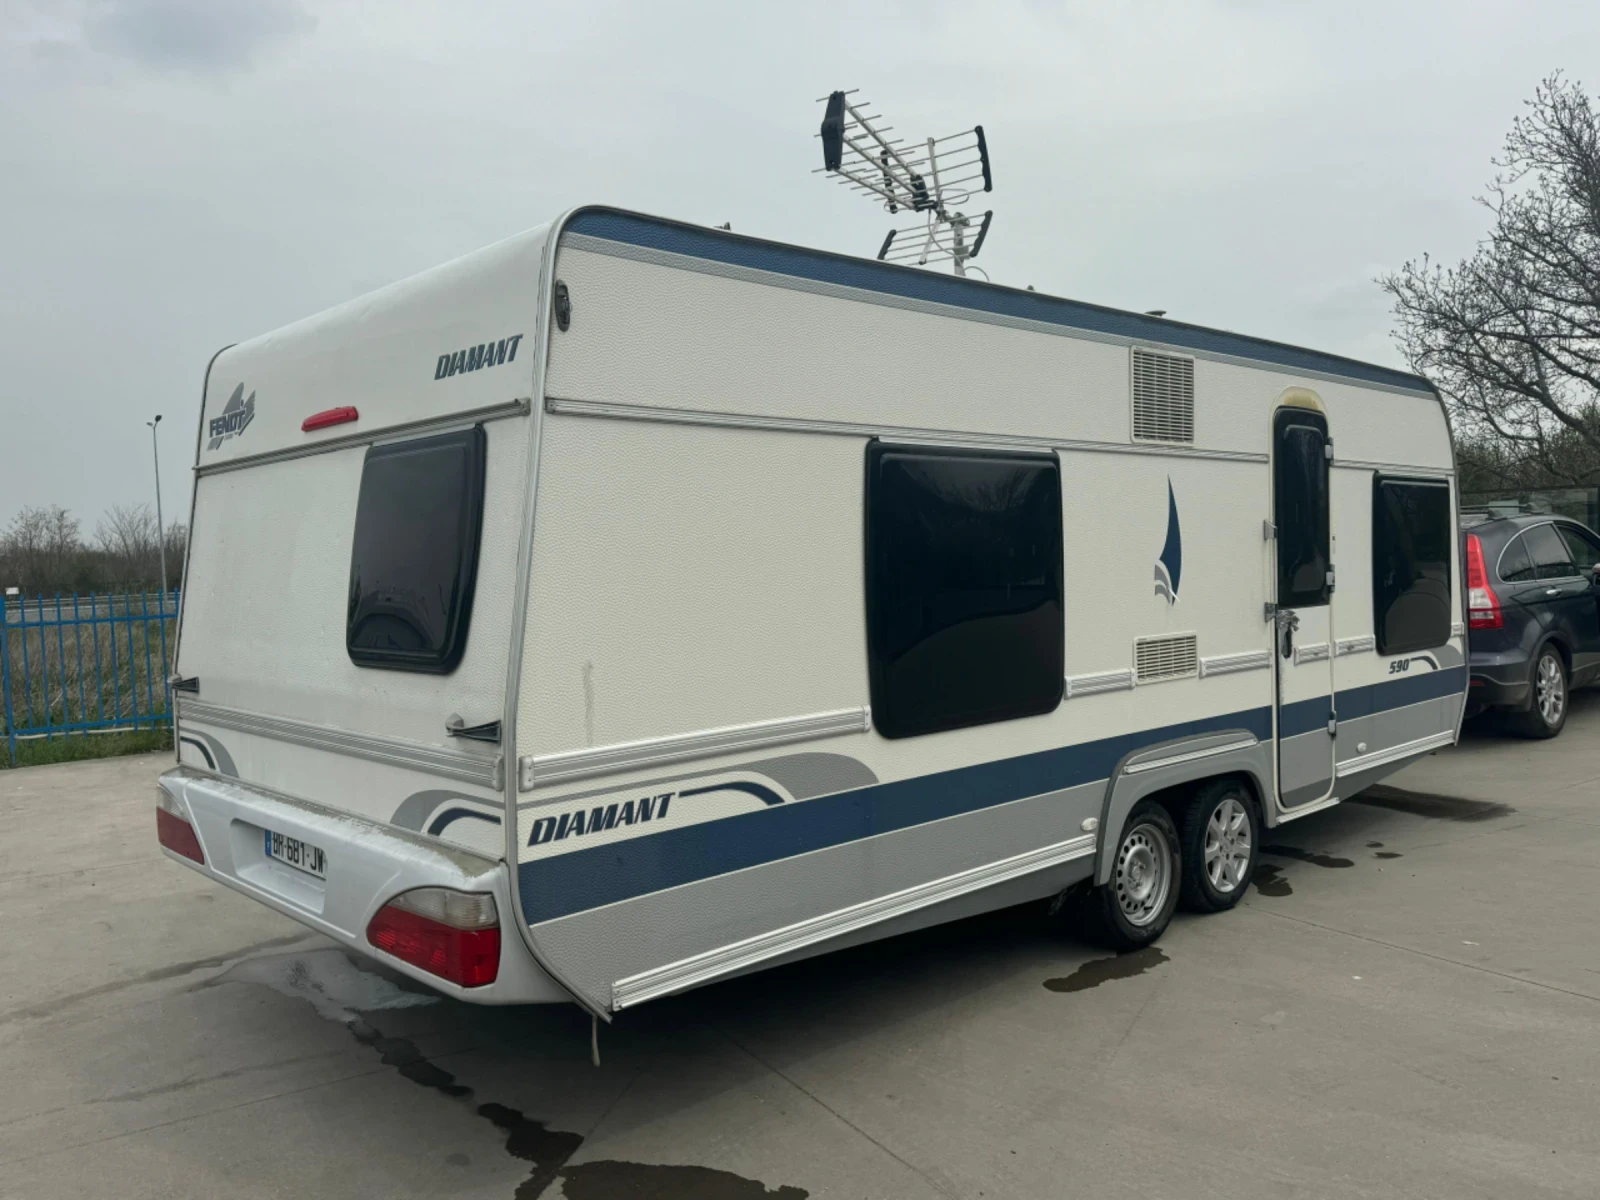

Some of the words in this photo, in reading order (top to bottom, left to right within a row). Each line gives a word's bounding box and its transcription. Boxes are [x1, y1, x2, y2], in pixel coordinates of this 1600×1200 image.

[434, 333, 524, 381] DIAMANT
[209, 409, 246, 438] FENDT
[1388, 658, 1410, 674] 590
[527, 791, 676, 847] DIAMANT
